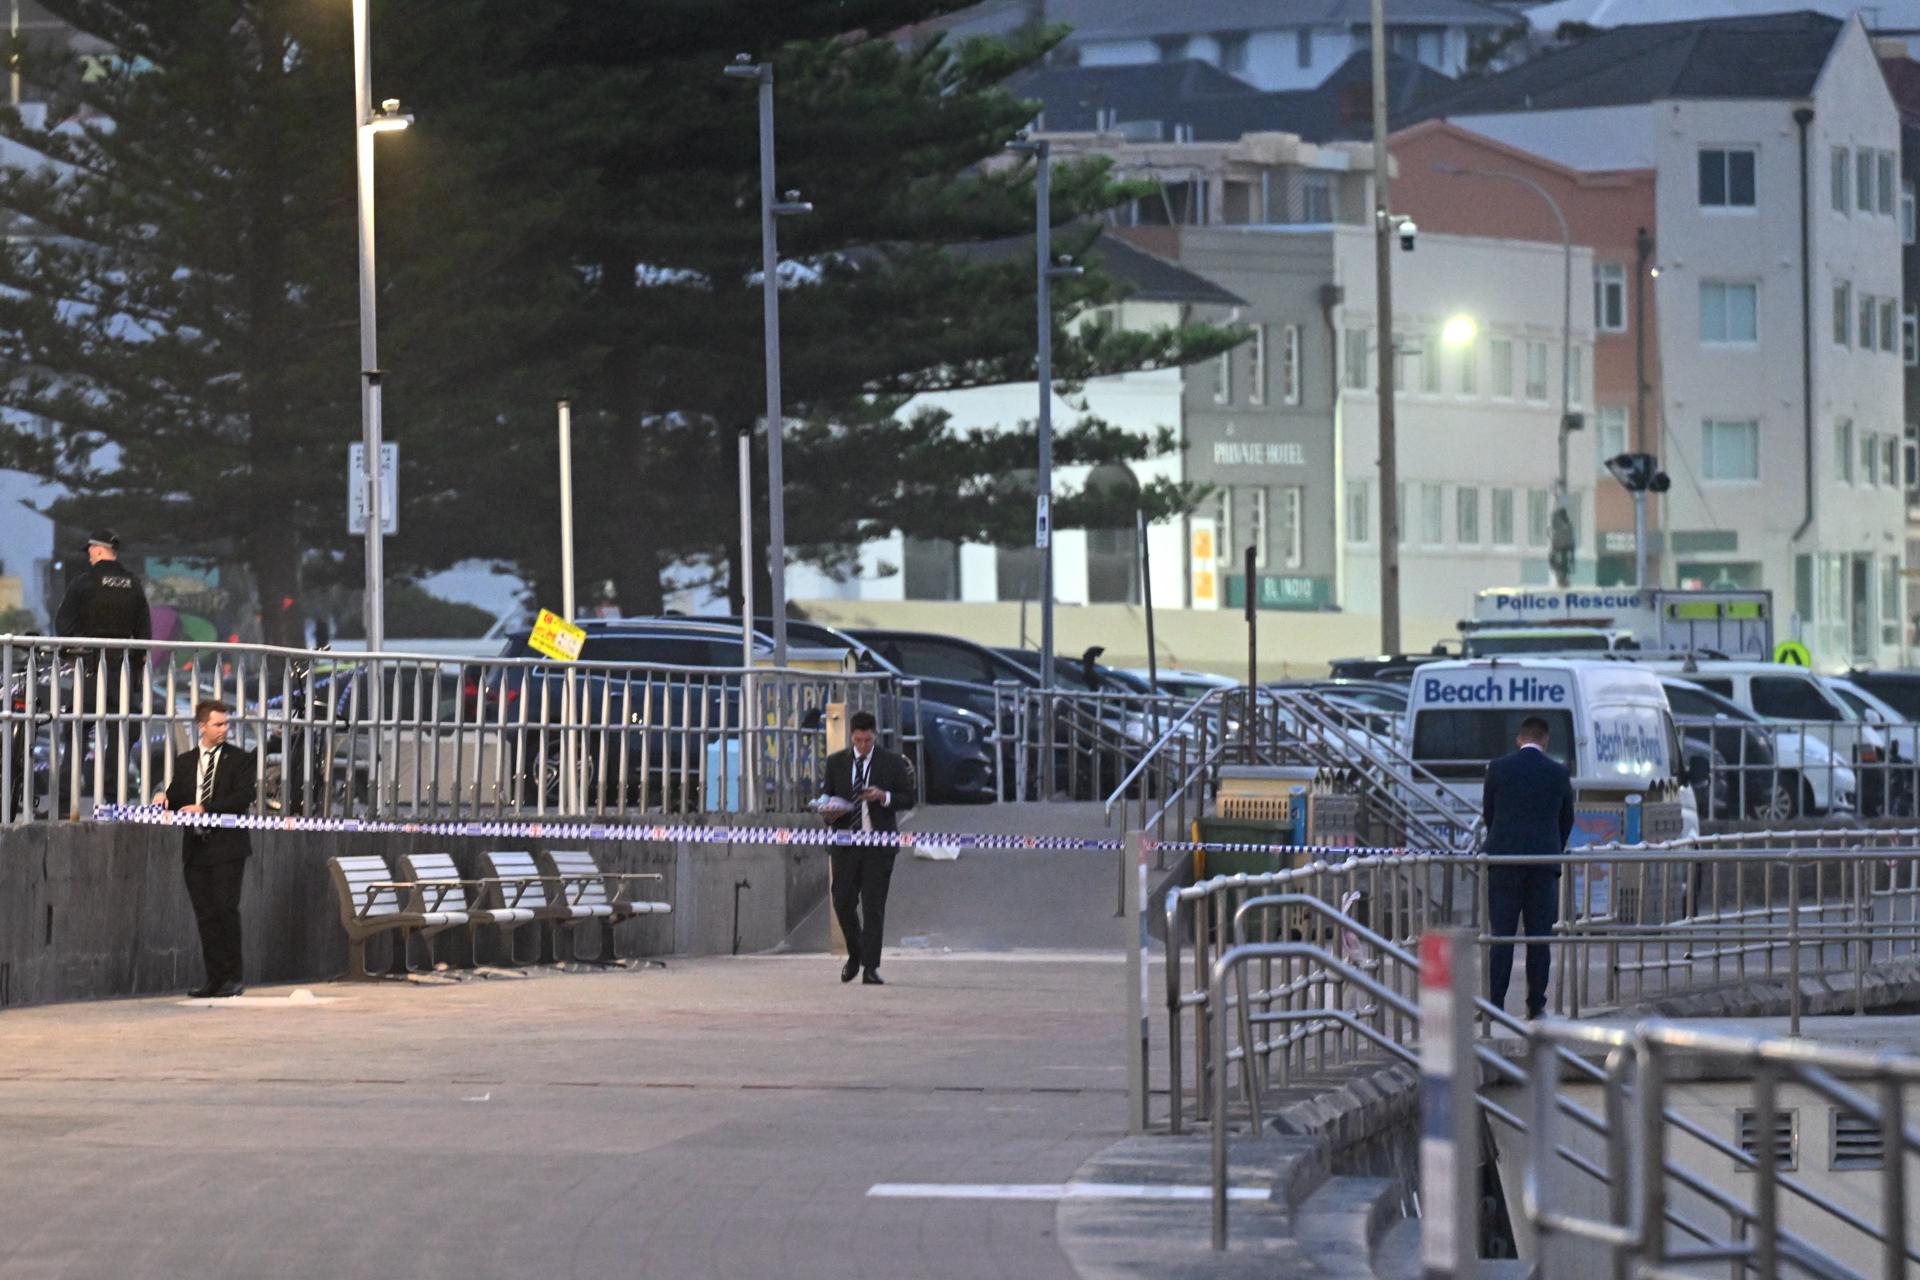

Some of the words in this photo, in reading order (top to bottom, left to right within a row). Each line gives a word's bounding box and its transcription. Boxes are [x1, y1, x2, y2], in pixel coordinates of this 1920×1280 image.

[1214, 442, 1265, 465] PRIVATE
[1266, 442, 1305, 465] HOTEL
[102, 576, 132, 588] POLICE
[1496, 593, 1559, 610] Police
[1565, 593, 1641, 609] Rescue
[1424, 677, 1503, 703] Beach
[1508, 677, 1566, 703] Hire
[1594, 720, 1621, 763] Beach
[1621, 722, 1639, 765] Hire
